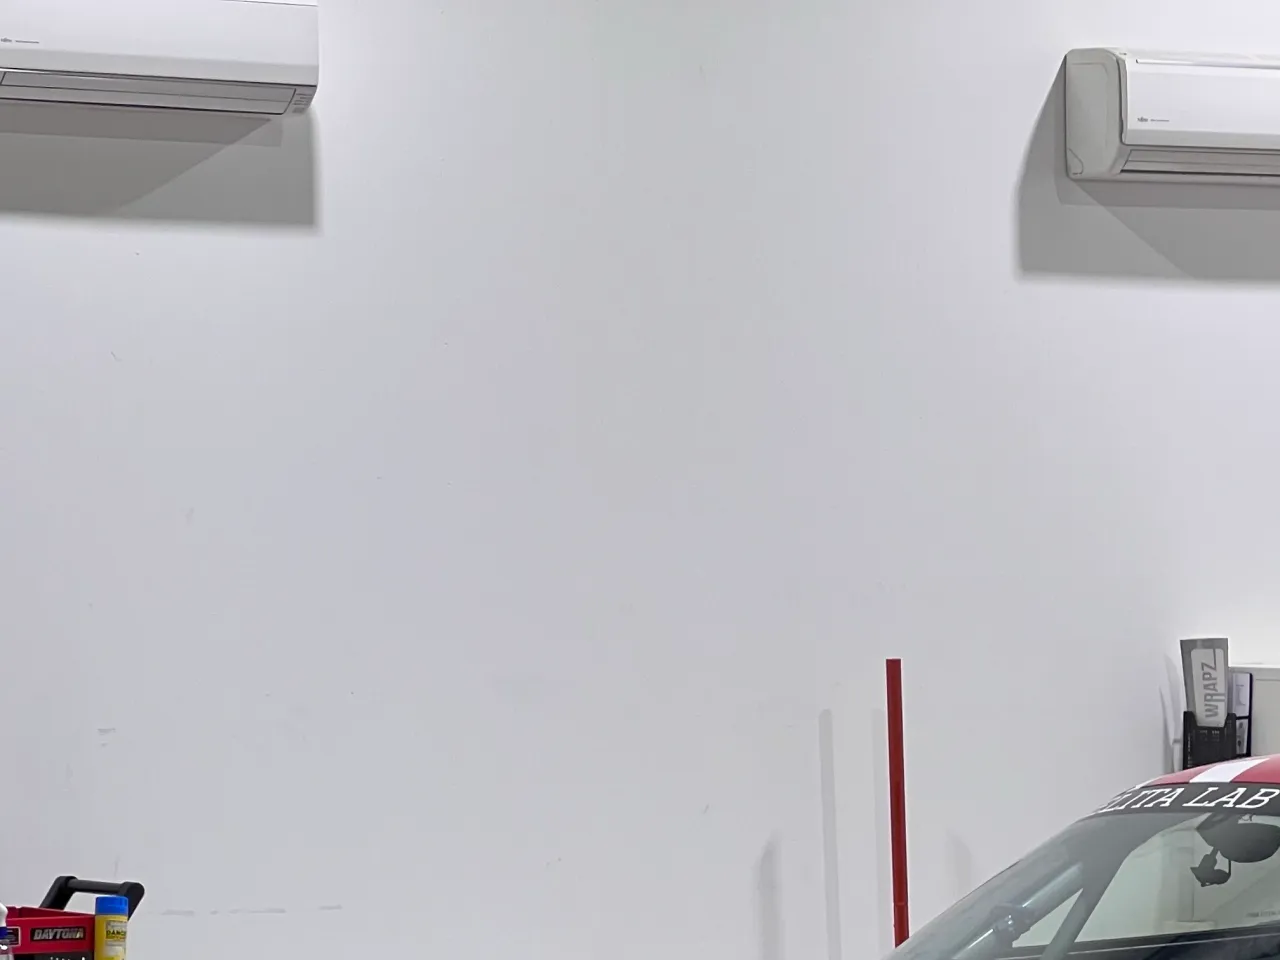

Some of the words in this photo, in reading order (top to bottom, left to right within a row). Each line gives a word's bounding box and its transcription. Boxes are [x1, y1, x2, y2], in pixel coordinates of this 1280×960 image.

[1201, 649, 1226, 718] WRAPZ
[1182, 787, 1279, 809] LAB
[33, 928, 84, 940] DAYTONA
